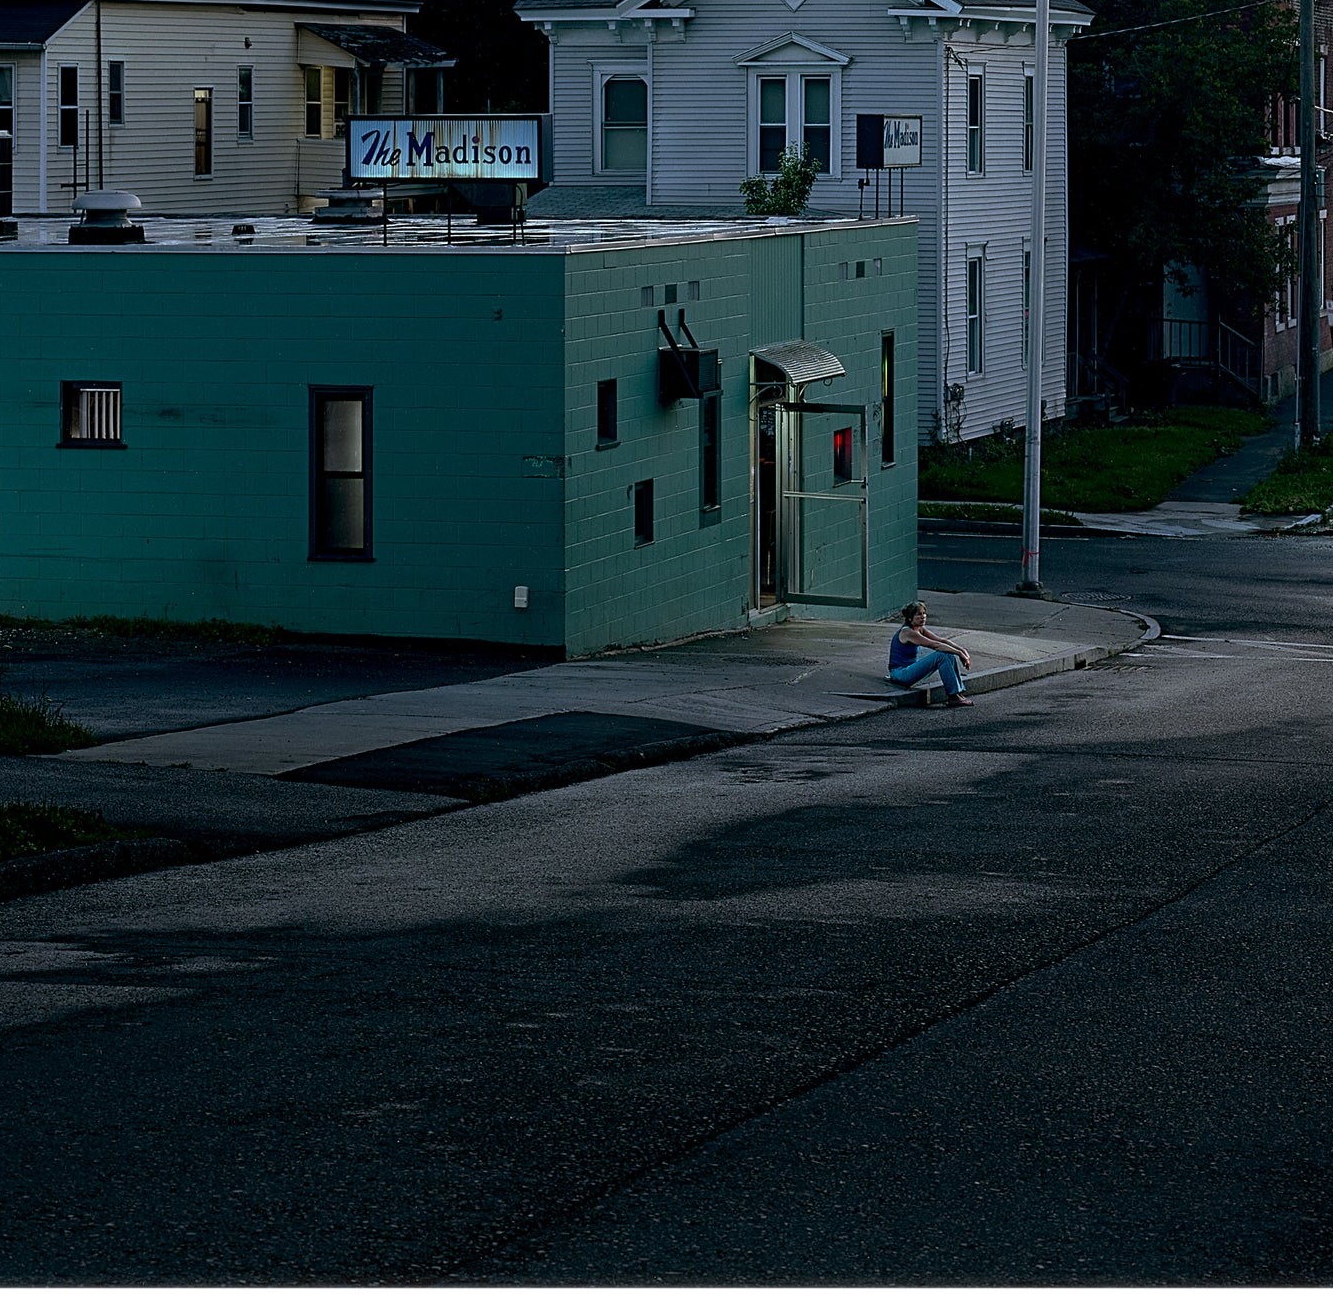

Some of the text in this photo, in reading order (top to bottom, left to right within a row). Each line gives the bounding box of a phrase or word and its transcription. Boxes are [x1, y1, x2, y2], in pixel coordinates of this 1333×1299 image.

[361, 129, 532, 167] The Madison
[894, 120, 918, 149] Madison
